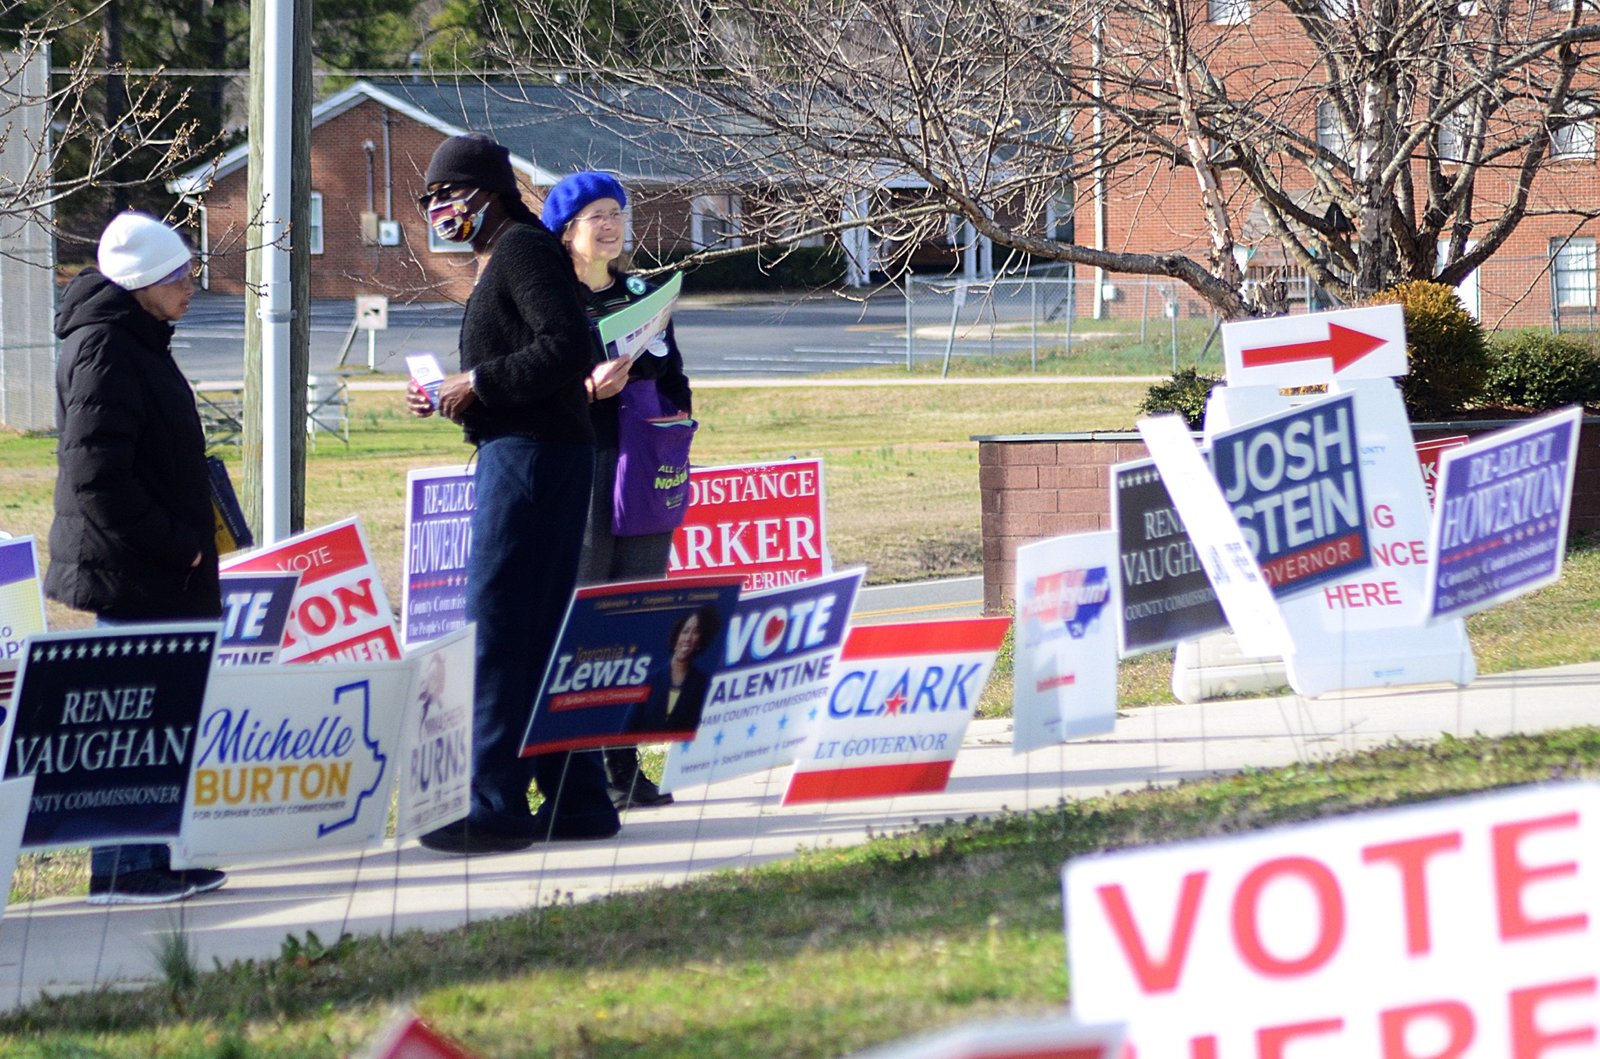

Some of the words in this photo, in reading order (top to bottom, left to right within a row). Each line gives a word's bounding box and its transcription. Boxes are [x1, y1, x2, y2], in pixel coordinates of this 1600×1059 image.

[1225, 407, 1352, 502] JOSH
[1468, 432, 1556, 488] RE-ELECT
[423, 482, 477, 515] RE-ELEC
[1231, 470, 1360, 558] STEIN
[1442, 461, 1568, 550] HOWERTON
[277, 546, 333, 572] VOTE
[1121, 541, 1201, 586] VAUGH
[1323, 581, 1403, 610] HERE
[724, 594, 838, 667] VOTE
[60, 686, 157, 726] RENEE
[723, 704, 761, 724] COUNTY
[762, 686, 829, 713] COMMISSIONER
[827, 663, 983, 720] CLARK
[15, 725, 193, 776] VAUGHAN
[197, 708, 355, 768] Michelle
[813, 741, 840, 760] LT
[842, 732, 948, 758] GOVERNOR
[64, 783, 182, 811] COMMISSIONER
[194, 761, 353, 807] BURTON
[192, 811, 212, 821] FOR
[251, 805, 285, 818] COUNTY
[1094, 809, 1590, 996] VOTE
